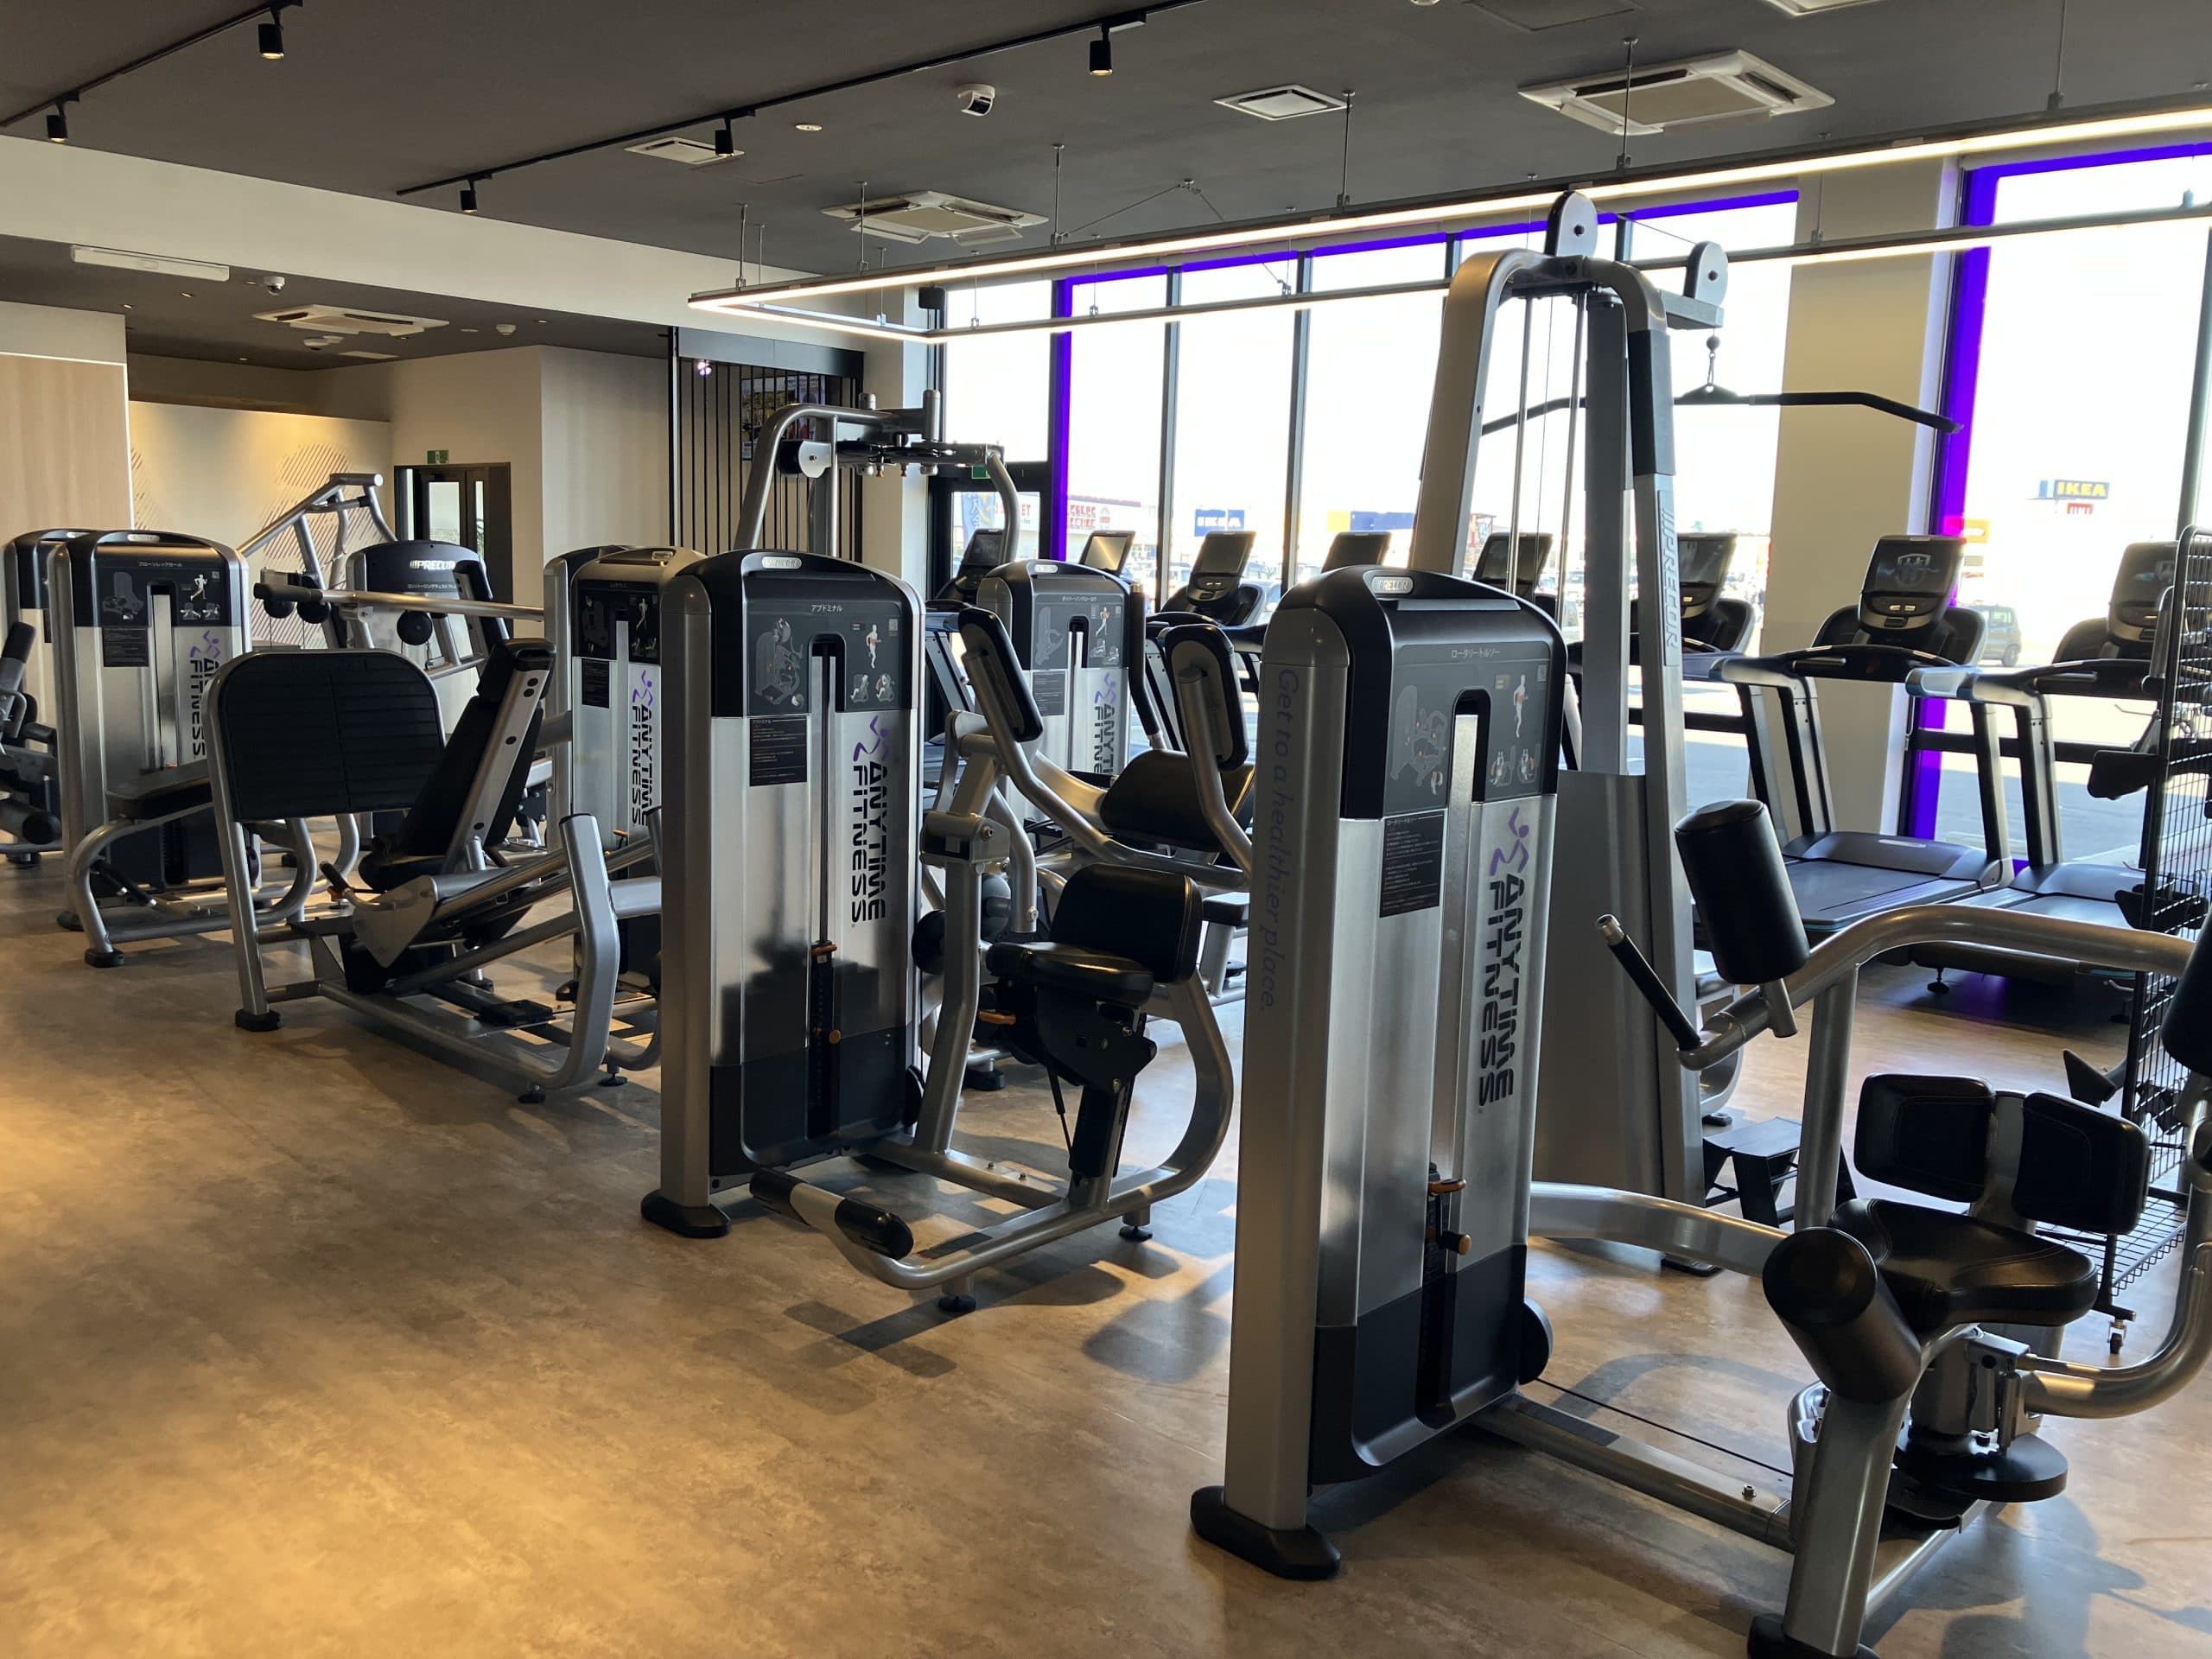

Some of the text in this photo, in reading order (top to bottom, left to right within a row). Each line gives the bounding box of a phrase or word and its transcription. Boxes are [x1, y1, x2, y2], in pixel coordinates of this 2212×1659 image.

[2057, 481, 2107, 497] IKEA
[1662, 530, 1678, 648] PRECOR
[1278, 668, 1300, 721] Get
[1451, 649, 1501, 659] ロータリートルソー
[632, 705, 641, 825] FITNESS
[641, 704, 652, 826] ANYTIME
[1094, 705, 1103, 774] FITNE
[1103, 703, 1116, 774] ANYTI
[1274, 765, 1287, 782] a
[1275, 732, 1291, 757] to
[851, 765, 868, 923] FITNESS
[868, 761, 887, 921] ANYTIME
[1266, 792, 1295, 923] healthier
[1478, 880, 1505, 1107] FITNESS
[1494, 873, 1525, 1102] ANYTIME
